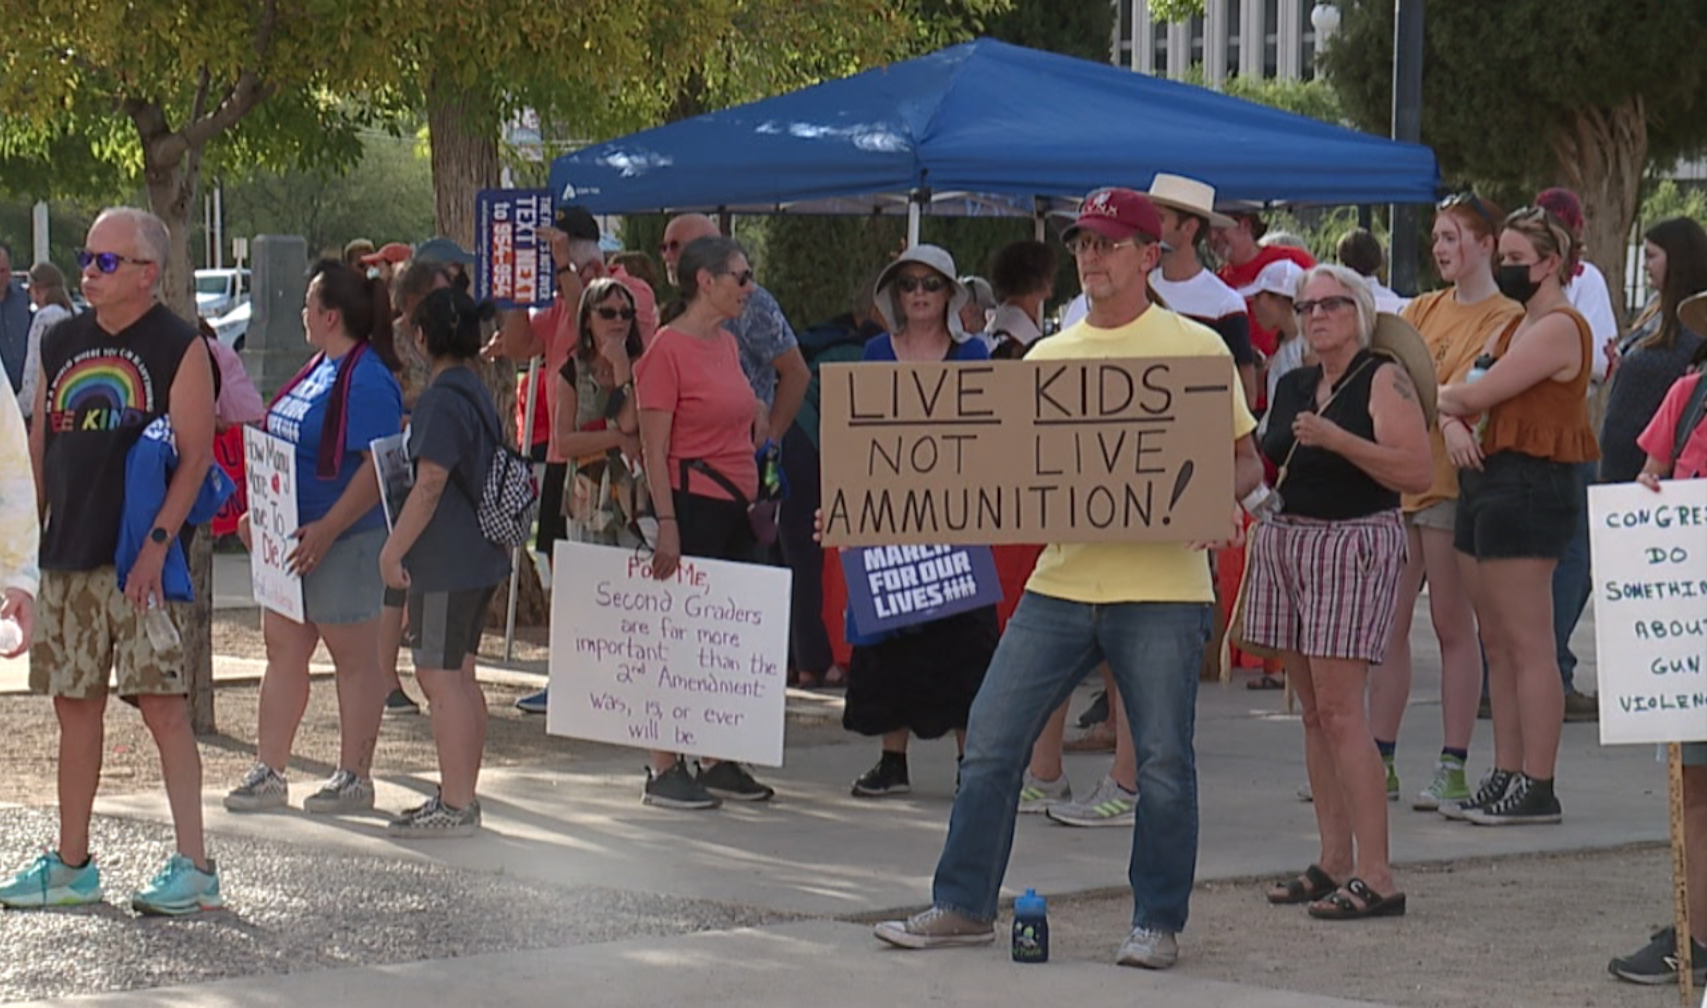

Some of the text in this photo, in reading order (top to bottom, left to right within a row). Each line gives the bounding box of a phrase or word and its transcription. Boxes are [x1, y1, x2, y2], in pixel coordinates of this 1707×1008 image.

[494, 201, 512, 298] to 954-954
[515, 195, 537, 303] TEXT NEXT
[849, 366, 1000, 419] LIVE
[51, 407, 144, 433] BE KIND
[869, 430, 1167, 476] NOT LIVE
[826, 459, 1194, 535] AMMUNITION!
[1606, 505, 1707, 528] CONGRE
[868, 550, 972, 595] FOR OUR
[1645, 547, 1688, 565] DO
[595, 581, 762, 626] Second Graders
[873, 583, 944, 619] LIVES
[621, 617, 740, 648] are far more
[576, 636, 778, 676] important than the
[1651, 655, 1700, 675] GUN
[616, 662, 766, 698] 2nd Amendment
[672, 705, 691, 719] or
[704, 708, 744, 727] ever
[1620, 692, 1707, 712] VIOLEN
[628, 719, 659, 740] will
